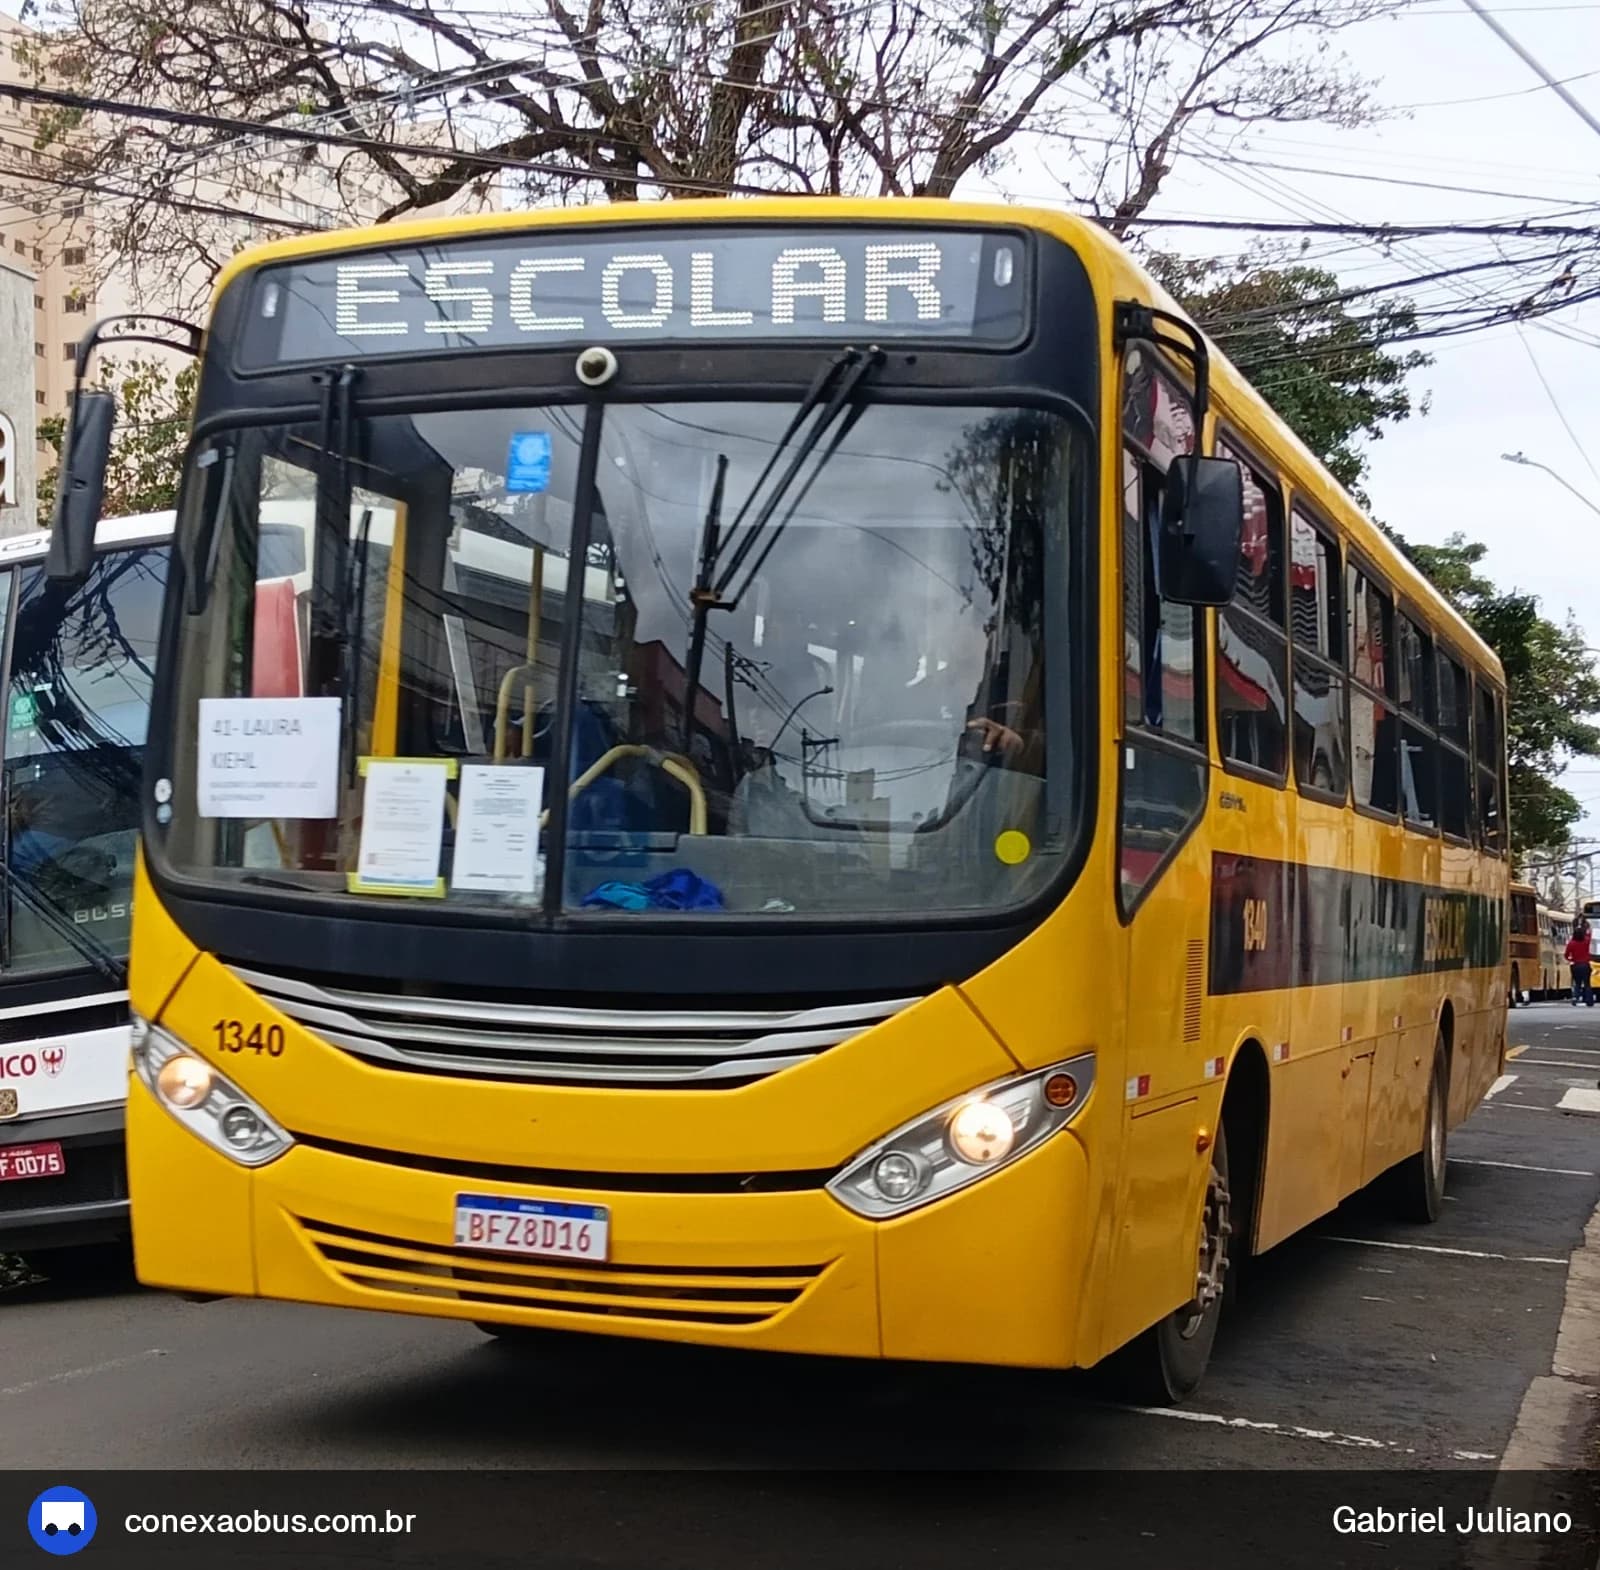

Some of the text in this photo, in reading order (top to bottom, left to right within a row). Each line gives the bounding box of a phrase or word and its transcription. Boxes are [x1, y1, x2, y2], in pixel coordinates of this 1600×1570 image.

[335, 241, 941, 336] ESCOLAR
[243, 719, 303, 736] LAURA
[1243, 899, 1267, 951] 1340
[213, 1018, 285, 1058] 1340
[469, 1212, 591, 1253] BFZ8D16
